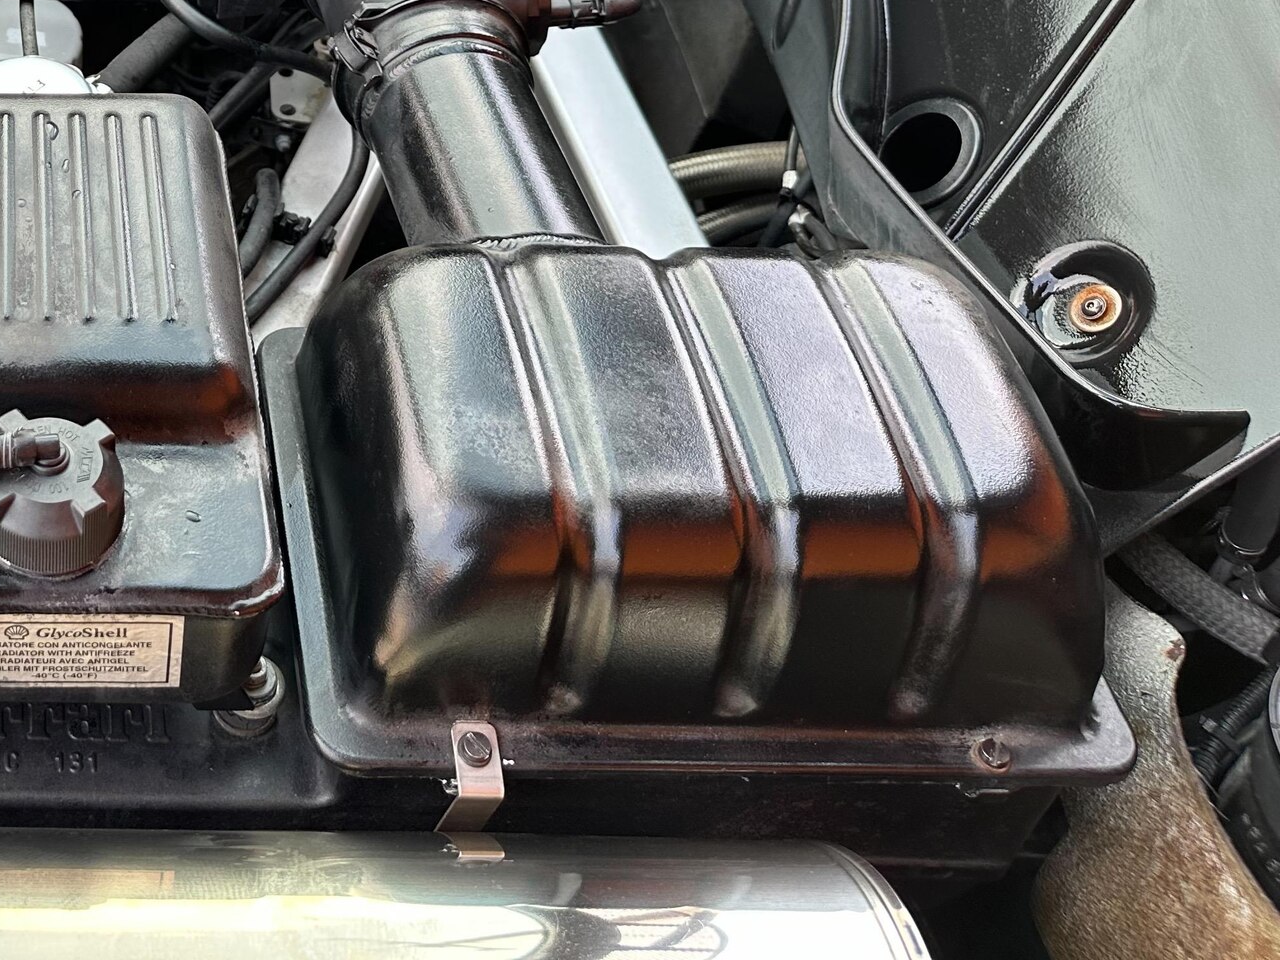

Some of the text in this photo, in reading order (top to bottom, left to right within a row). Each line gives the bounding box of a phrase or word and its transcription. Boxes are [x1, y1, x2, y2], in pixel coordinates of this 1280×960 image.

[59, 425, 80, 442] HOT
[36, 627, 127, 640] GlycoShell
[37, 641, 59, 649] CON
[61, 641, 152, 649] ANTICONGELANTE
[47, 649, 72, 657] WITH
[74, 649, 136, 657] ANTIFREEZE
[0, 657, 130, 665] RADIATEUR AVEC ANTIGEL
[23, 665, 39, 673] MIT
[42, 665, 149, 673] FROSTSCHUTZMITTEL
